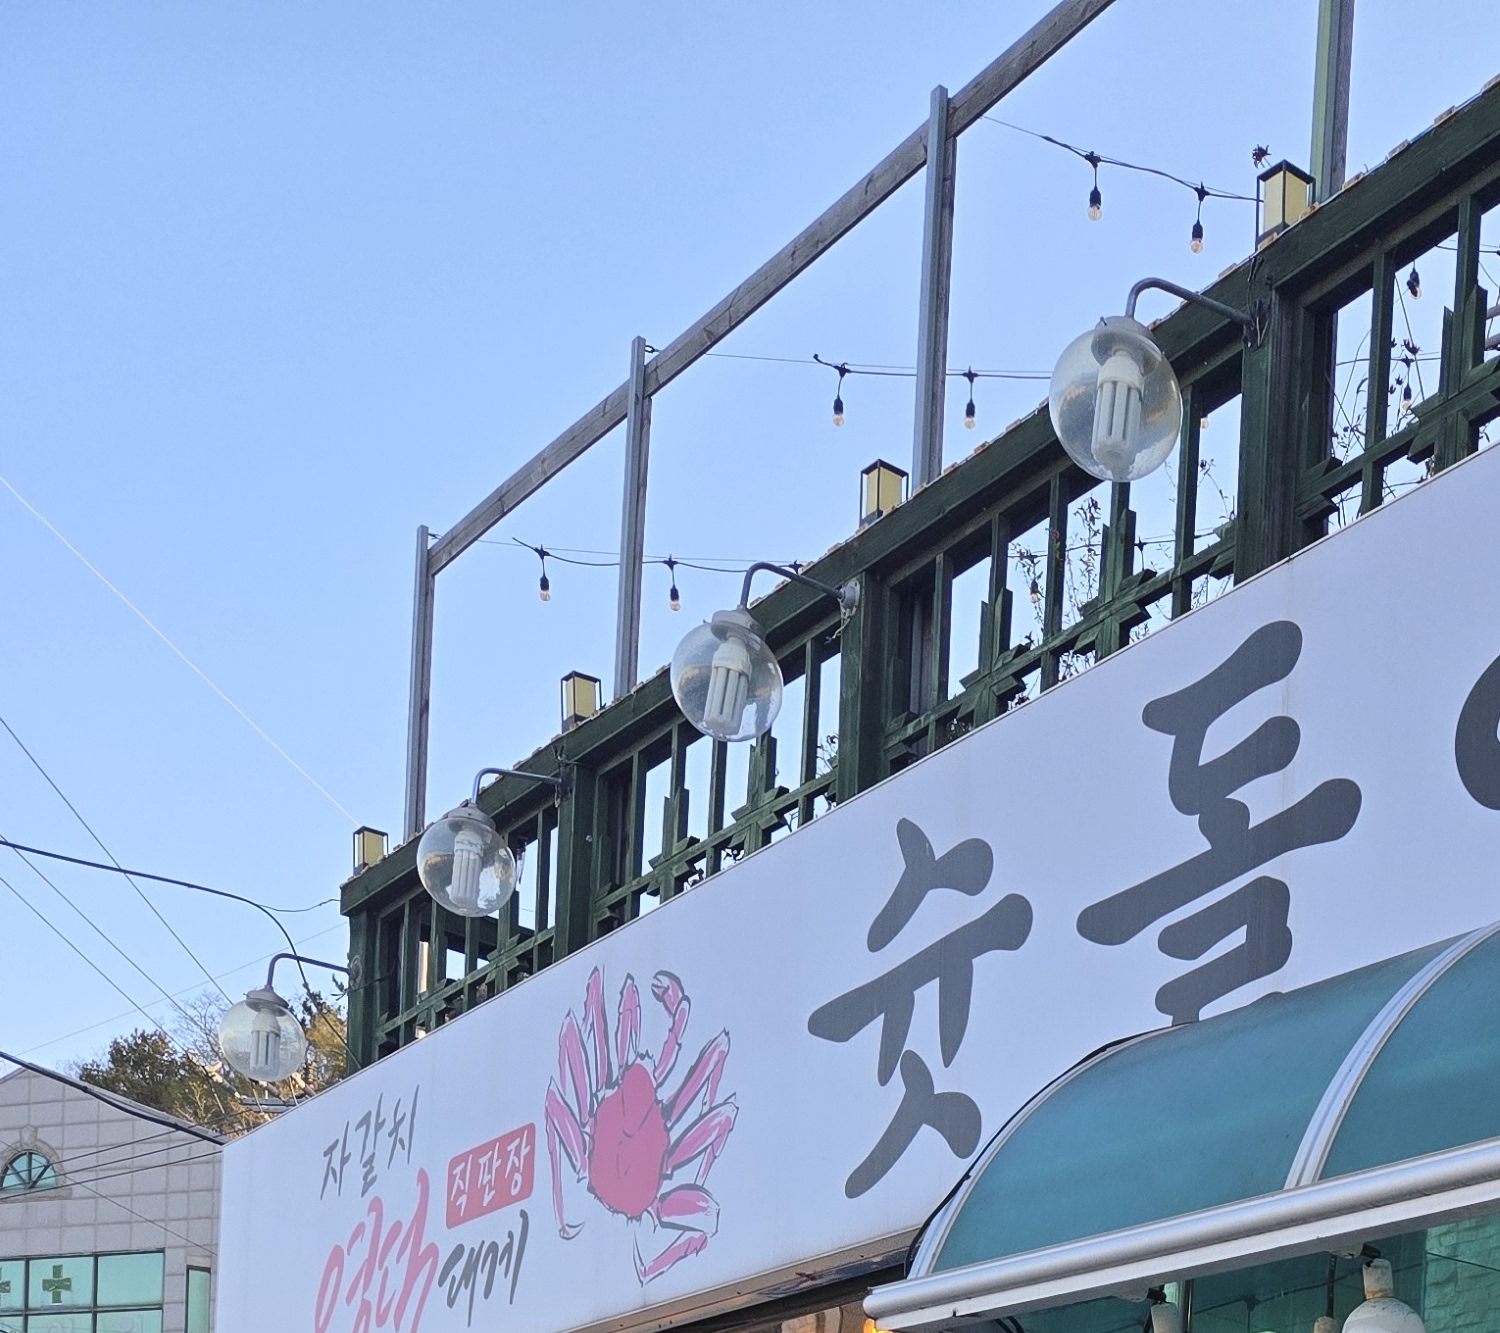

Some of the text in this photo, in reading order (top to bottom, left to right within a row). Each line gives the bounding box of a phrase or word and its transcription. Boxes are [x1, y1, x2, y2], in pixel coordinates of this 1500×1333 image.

[319, 1084, 420, 1200] 자갈치
[451, 1129, 530, 1217] 직판장
[438, 1208, 529, 1328] 대게
